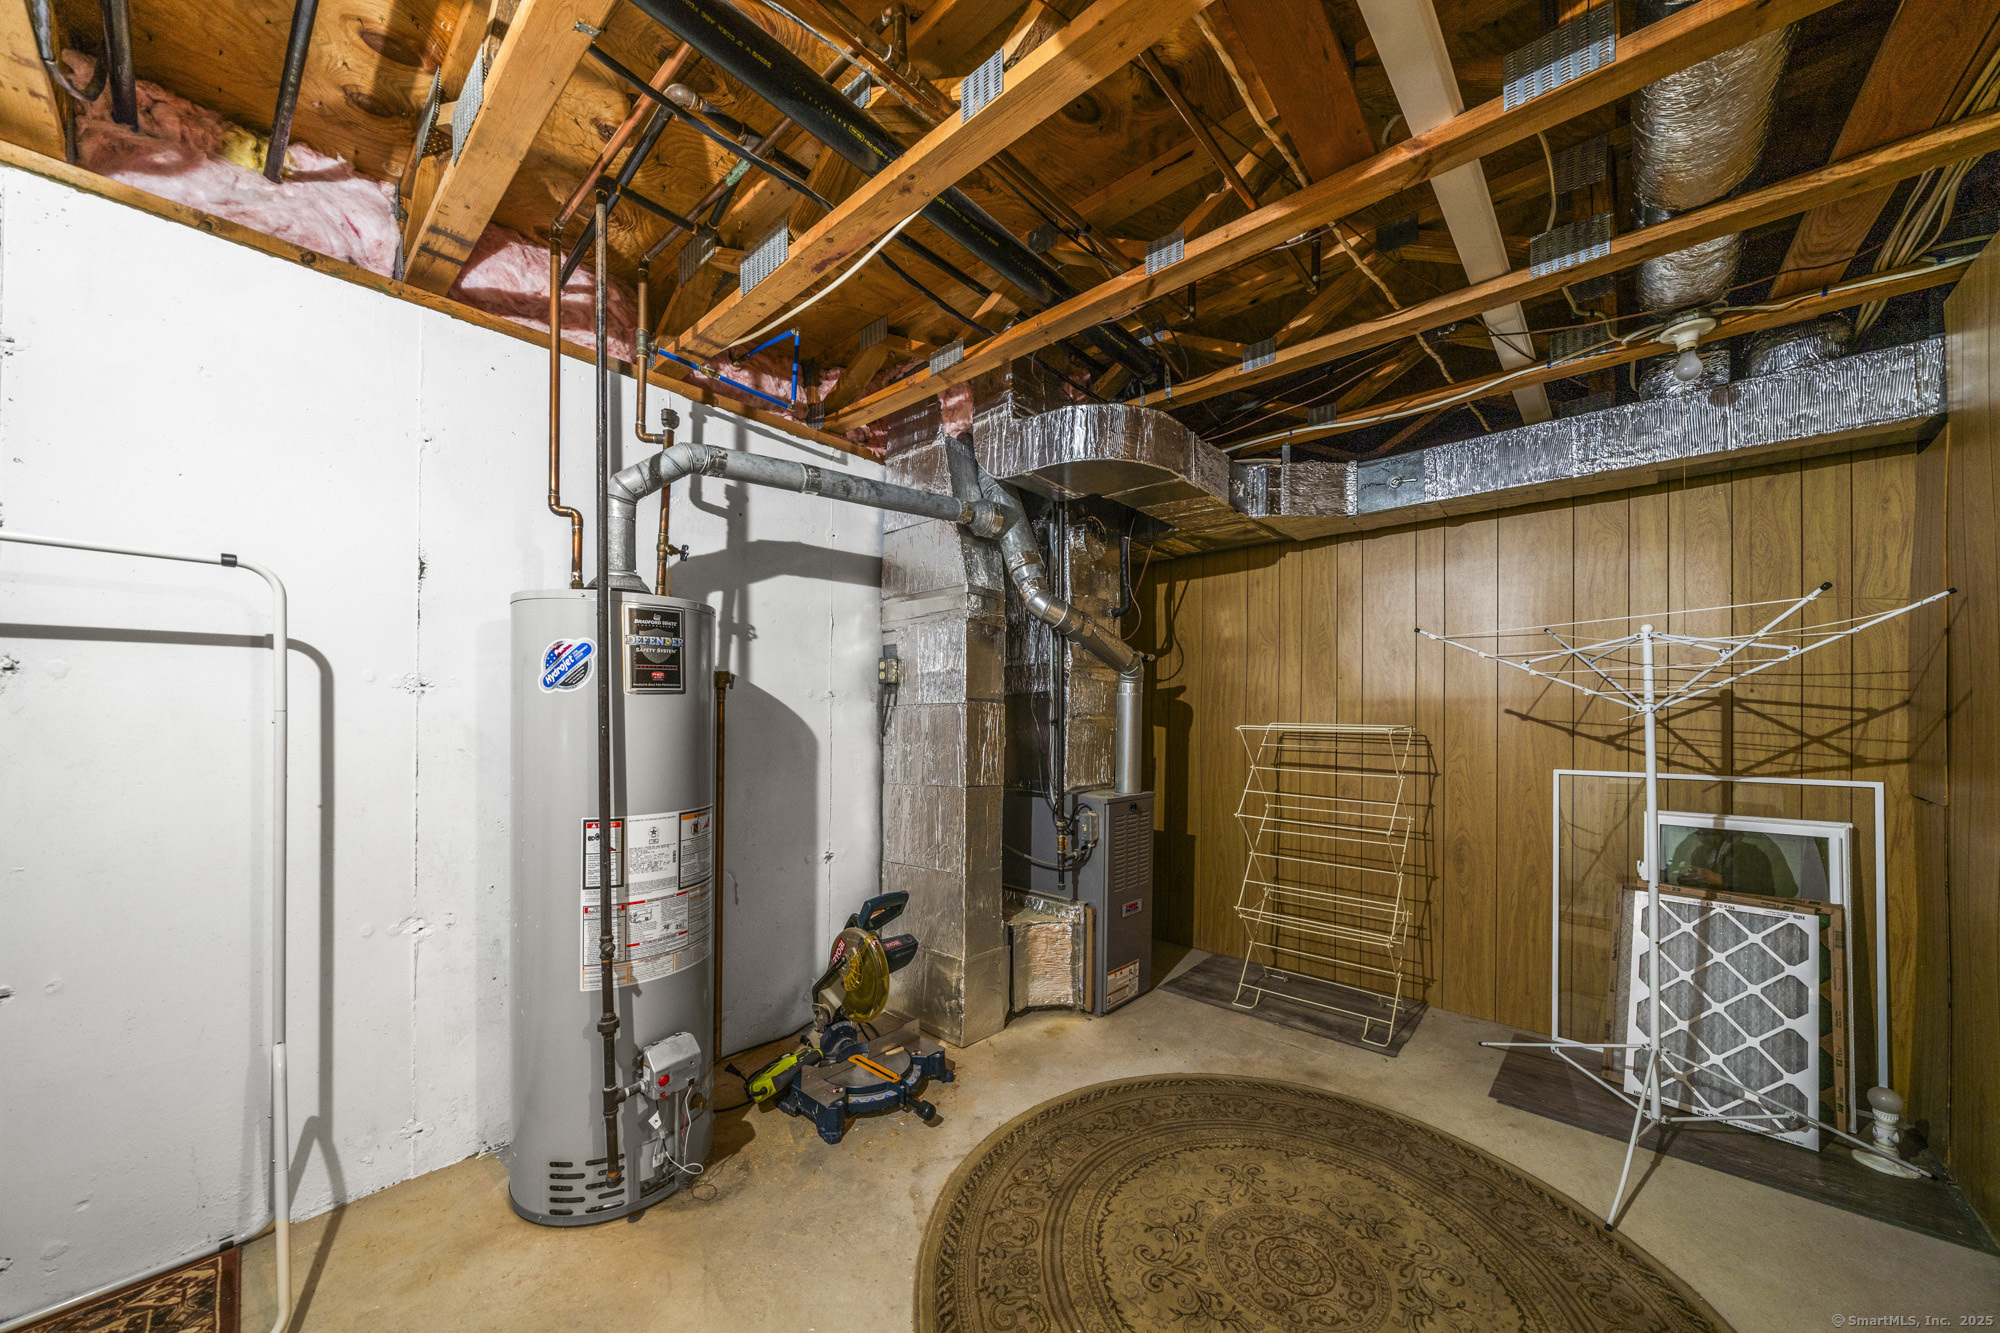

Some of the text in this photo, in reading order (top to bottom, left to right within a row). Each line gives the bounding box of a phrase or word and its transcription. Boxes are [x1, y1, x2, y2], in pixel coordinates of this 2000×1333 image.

[634, 618, 662, 626] BRADFORD
[625, 635, 684, 647] DEFENDER
[544, 654, 575, 685] Hydrojet
[832, 940, 847, 964] RYOBI
